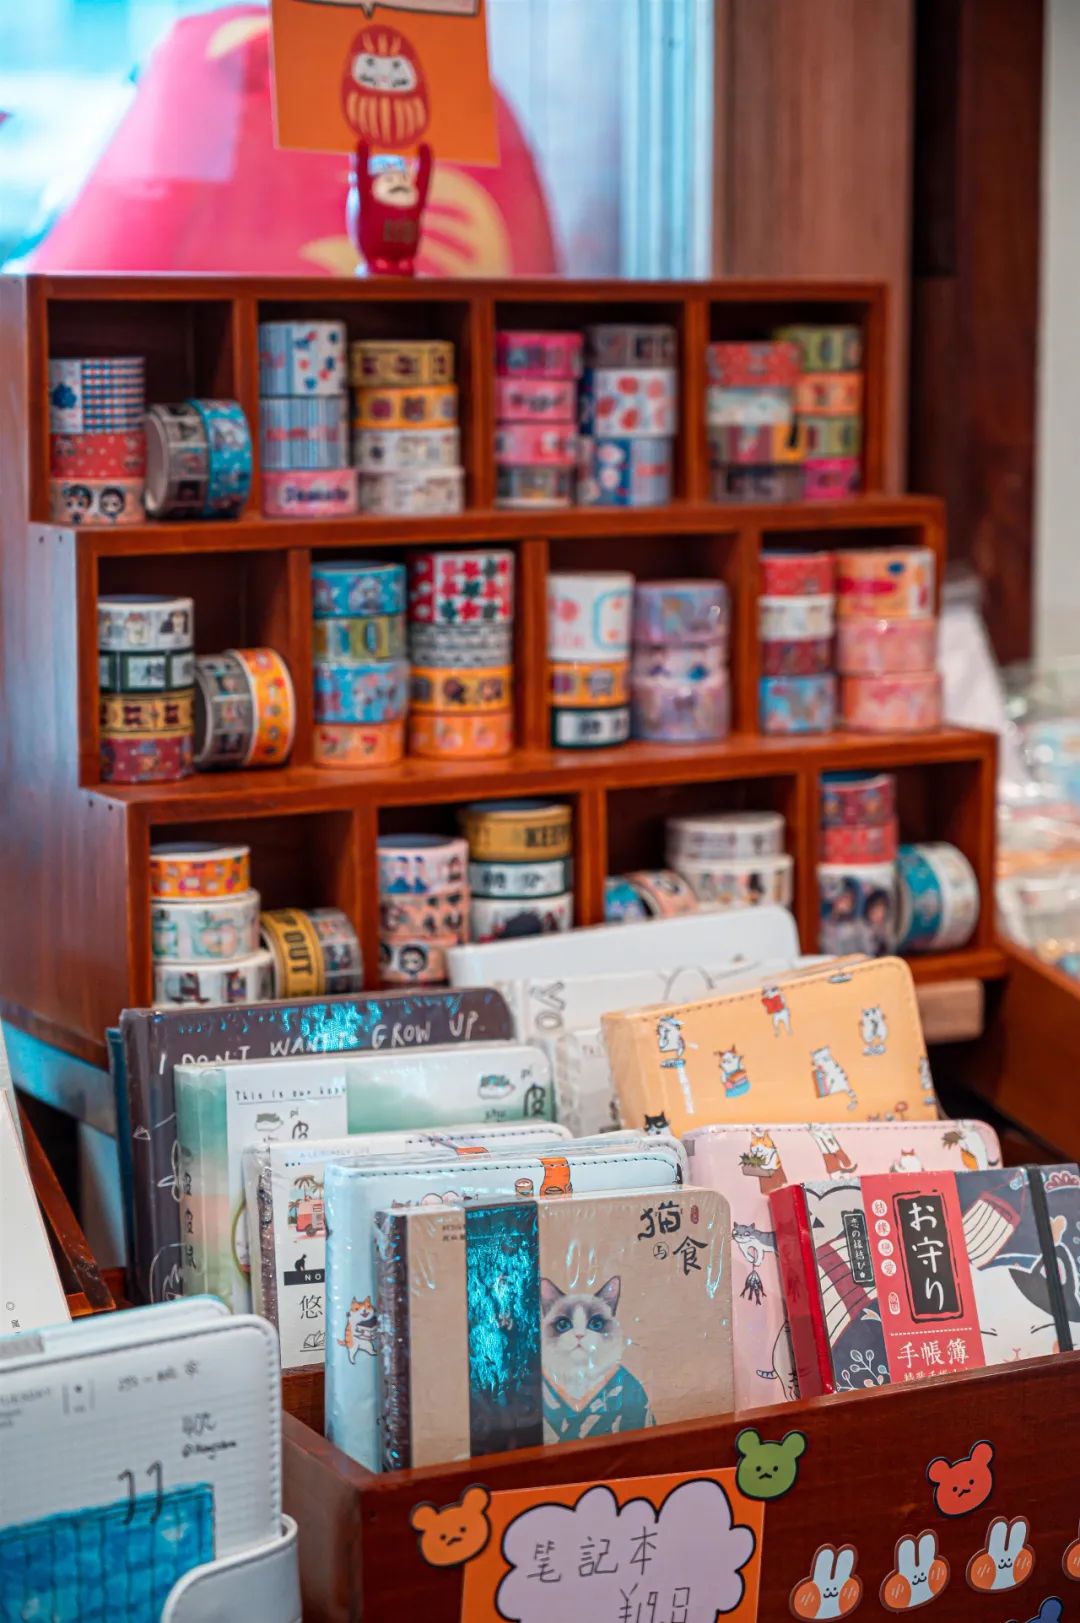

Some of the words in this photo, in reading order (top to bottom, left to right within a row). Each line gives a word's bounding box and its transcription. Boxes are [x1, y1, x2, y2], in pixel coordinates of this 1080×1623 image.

[284, 930, 313, 976] OUT
[372, 1021, 431, 1049] GROW
[235, 1091, 263, 1102] This
[272, 1089, 284, 1099] is
[908, 1202, 945, 1311] お守り
[300, 1294, 324, 1320] 悠
[897, 1337, 969, 1369] 手帳簿
